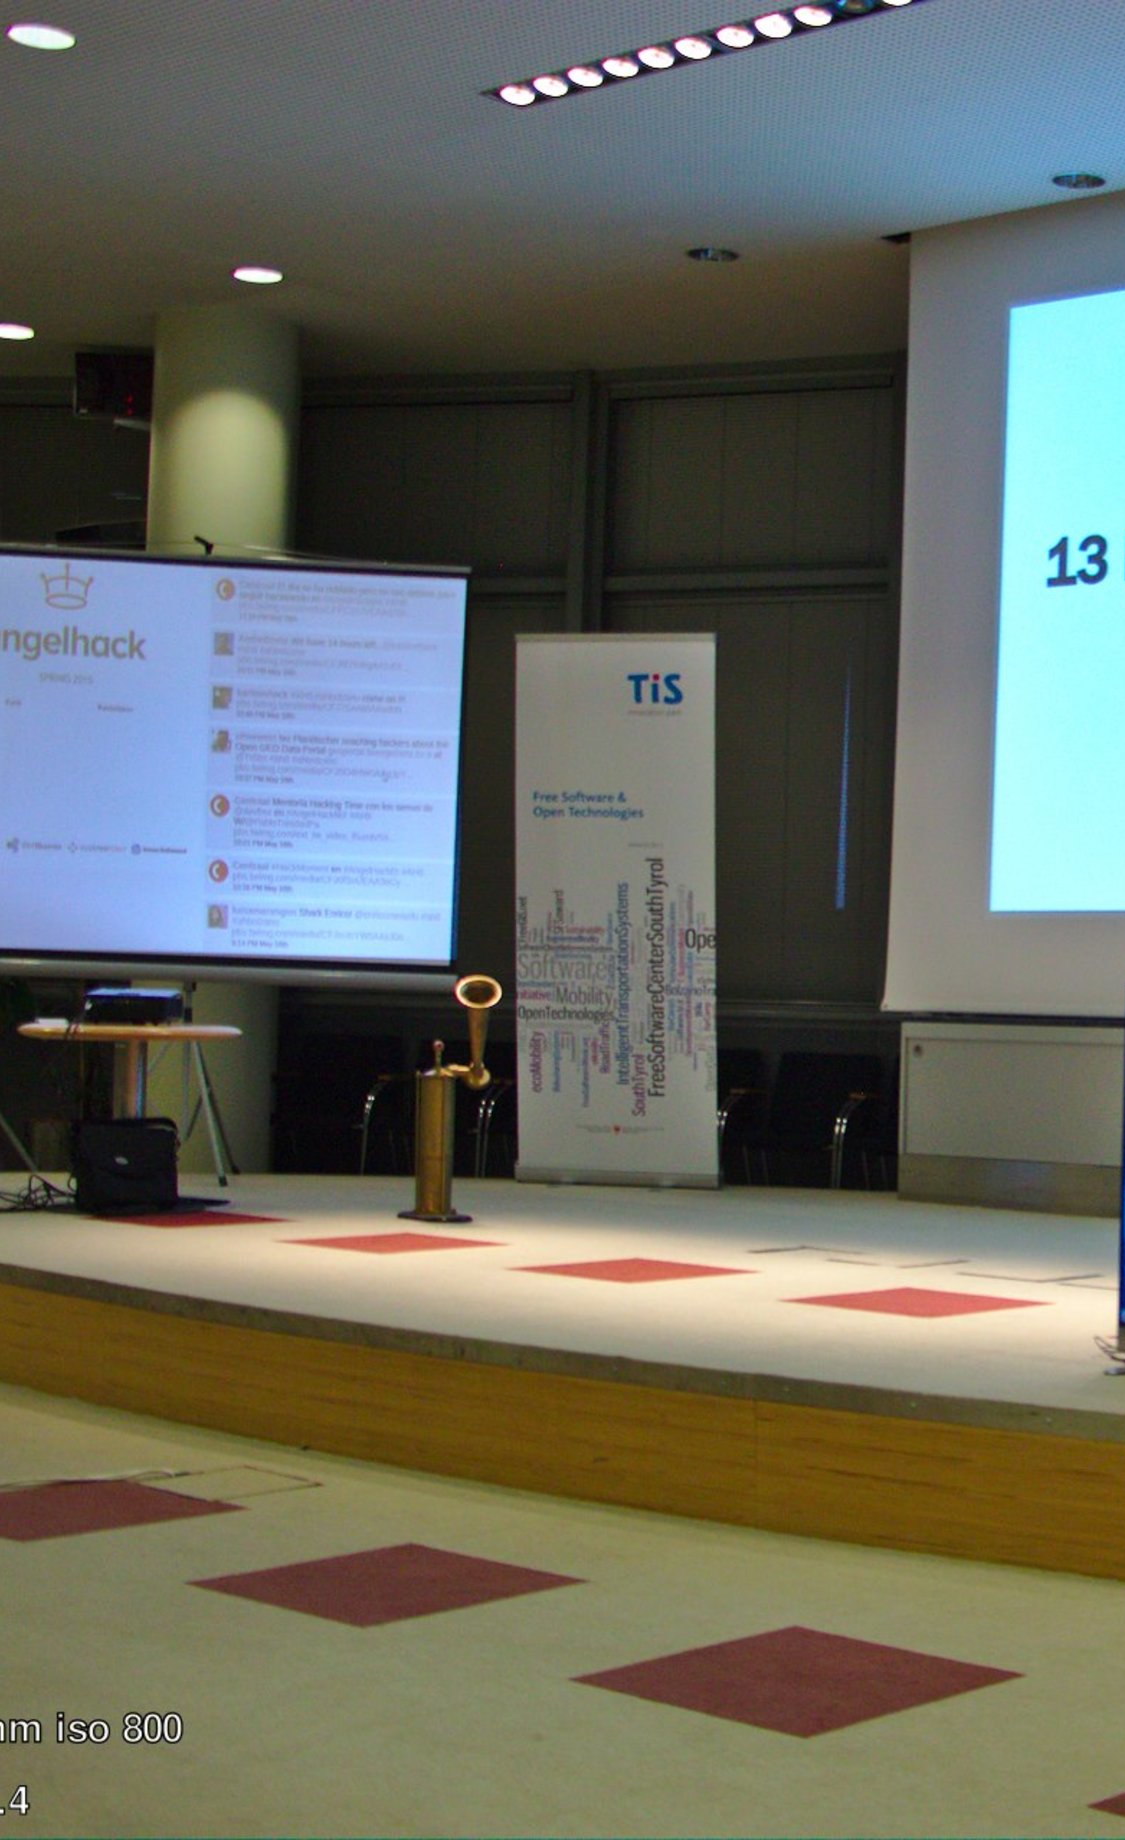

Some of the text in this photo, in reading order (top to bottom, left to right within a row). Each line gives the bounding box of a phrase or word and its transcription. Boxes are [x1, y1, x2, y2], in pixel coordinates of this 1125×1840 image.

[1046, 535, 1109, 588] 13
[533, 790, 627, 803] Free Software &
[533, 807, 644, 821] Open Technologies
[556, 985, 614, 1009] Mobility
[616, 882, 632, 1086] IntelligentTransportationSystems
[645, 857, 668, 1097] FreeSoftwareCenterSouthTyrol
[518, 1006, 616, 1023] OpenTechnologies
[529, 1031, 545, 1093] ecoMobility
[631, 1054, 648, 1117] SouthTyrol
